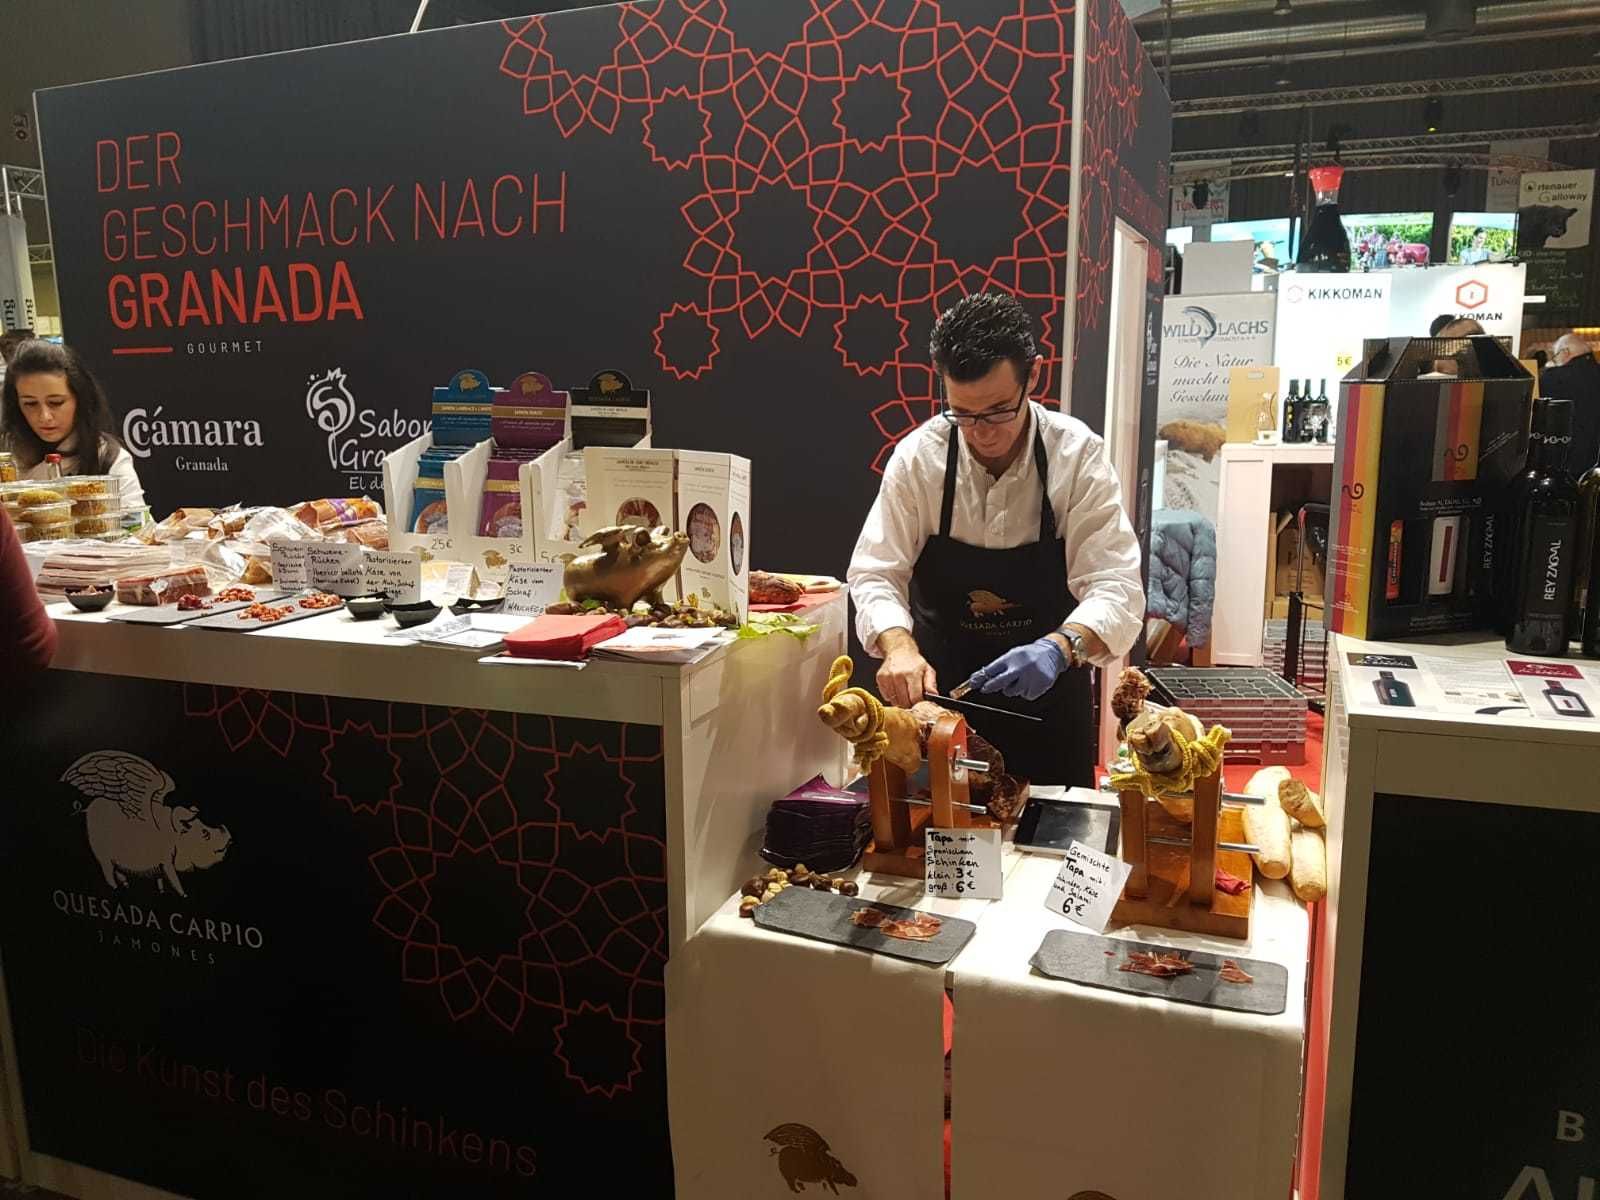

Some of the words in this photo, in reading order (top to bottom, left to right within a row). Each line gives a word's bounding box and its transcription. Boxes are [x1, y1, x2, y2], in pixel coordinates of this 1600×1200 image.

[96, 131, 182, 193] DER
[103, 184, 396, 262] GESCHMACK
[414, 171, 567, 241] NACH
[107, 260, 364, 330] GRANADA
[1308, 288, 1384, 300] KIKKOMAN
[1163, 321, 1202, 338] WILD
[1217, 320, 1269, 336] LACHS
[187, 339, 264, 354] GOURMET
[1174, 354, 1202, 369] Die
[1172, 371, 1218, 386] macht
[176, 455, 229, 472] Granada
[1544, 578, 1556, 600] REY
[928, 832, 953, 846] Tapa
[928, 857, 980, 869] Schinken
[1065, 857, 1084, 878] Tapa
[1069, 846, 1111, 873] Gemischte
[52, 889, 161, 930] QUESADA
[169, 912, 263, 949] CARPIO
[97, 929, 216, 964] JAMONES
[76, 1026, 127, 1073] Die
[136, 1042, 236, 1103] Kunst
[246, 1074, 312, 1121] des
[322, 1087, 538, 1177] Schinkens
